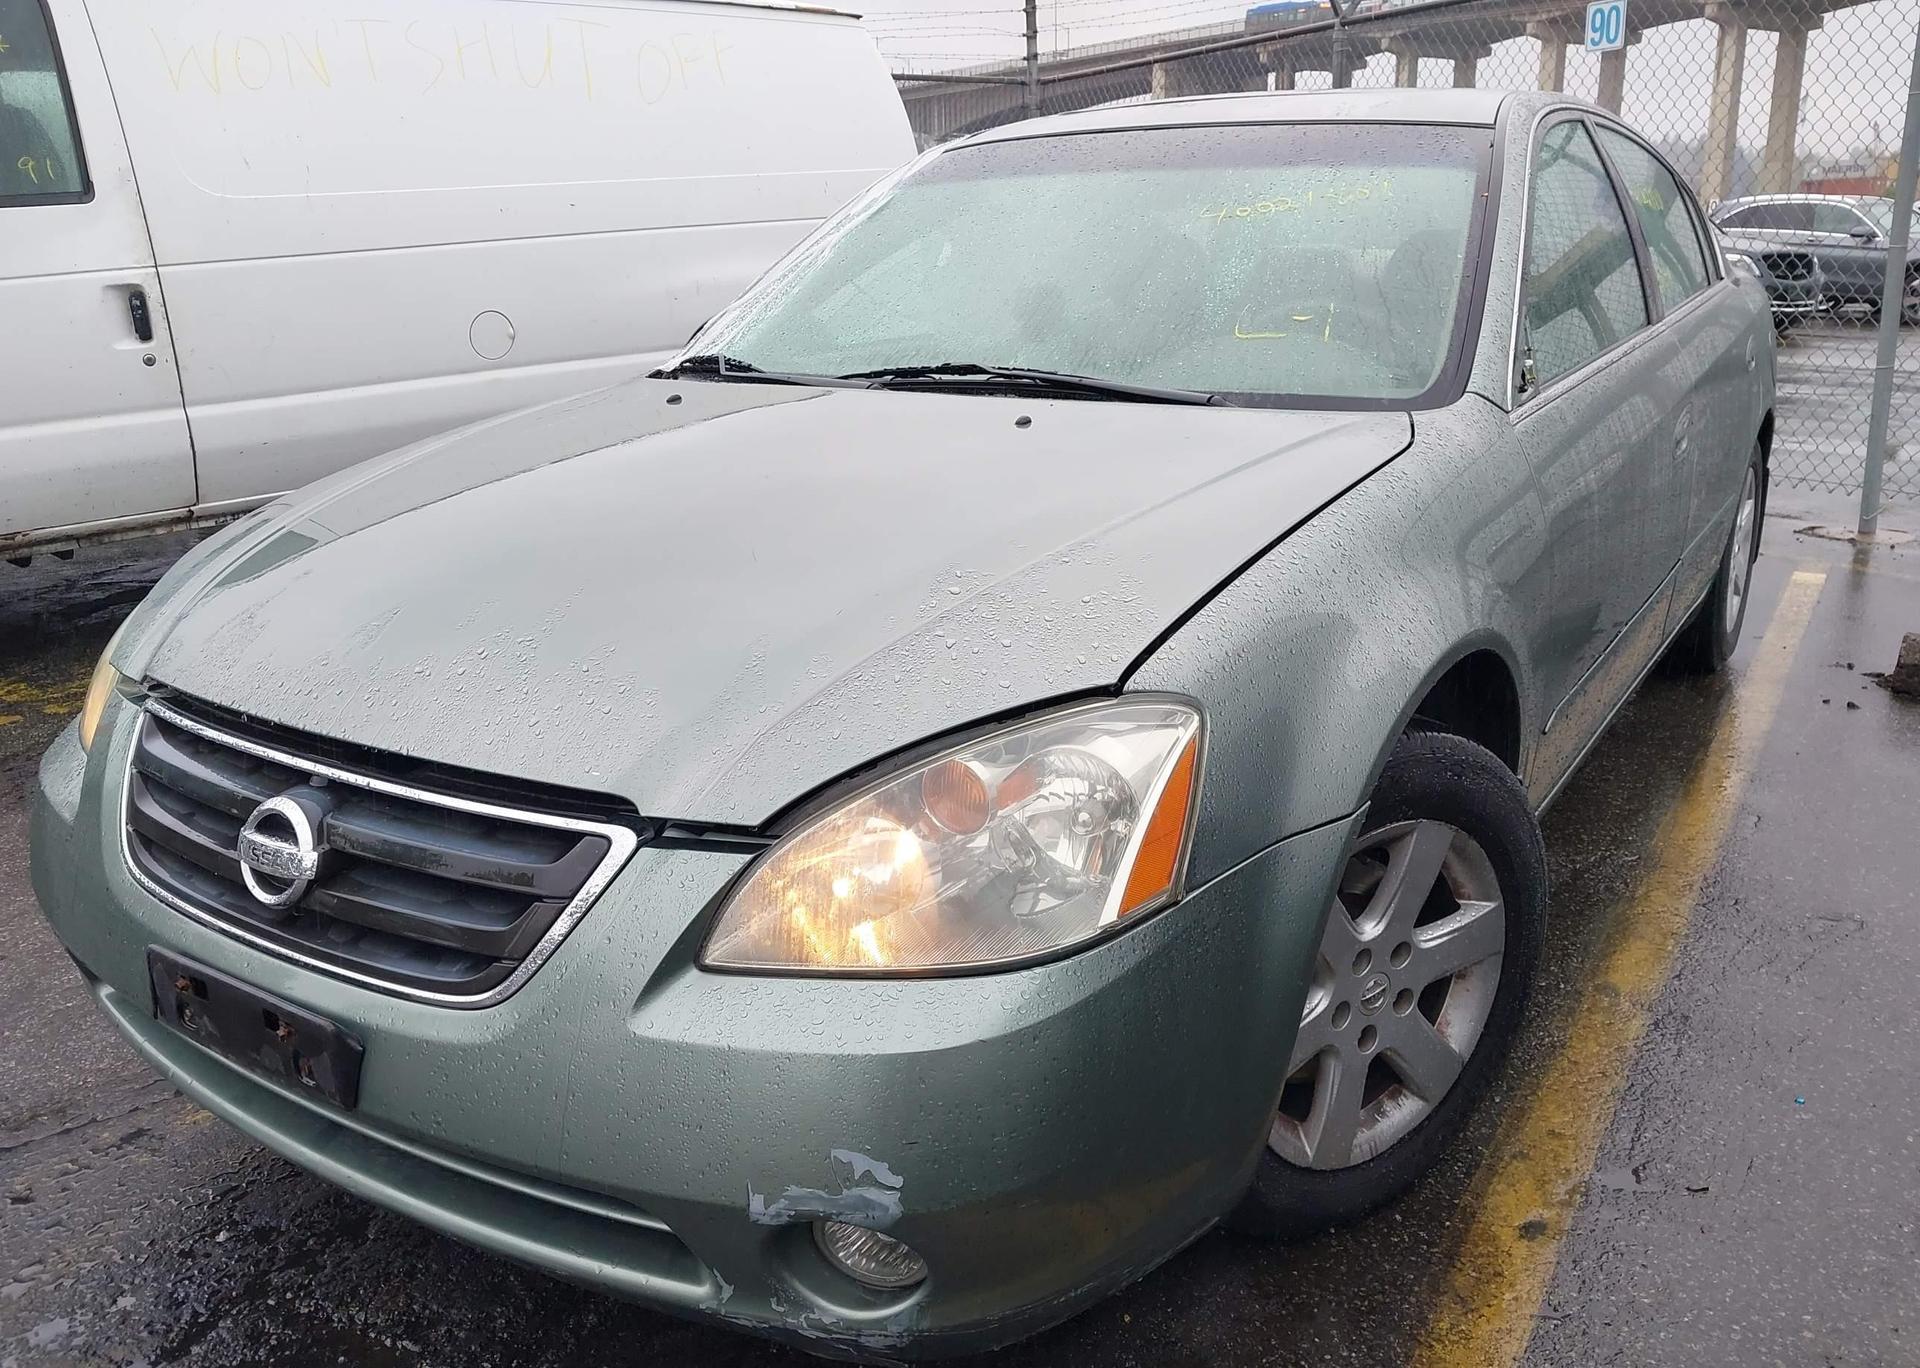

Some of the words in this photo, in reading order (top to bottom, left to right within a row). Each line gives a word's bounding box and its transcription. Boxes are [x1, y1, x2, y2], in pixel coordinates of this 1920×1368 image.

[1590, 5, 1620, 46] 90
[402, 17, 611, 102] SHUT
[637, 30, 735, 105] OFF
[17, 156, 55, 184] 91
[243, 840, 303, 876] SSAN
